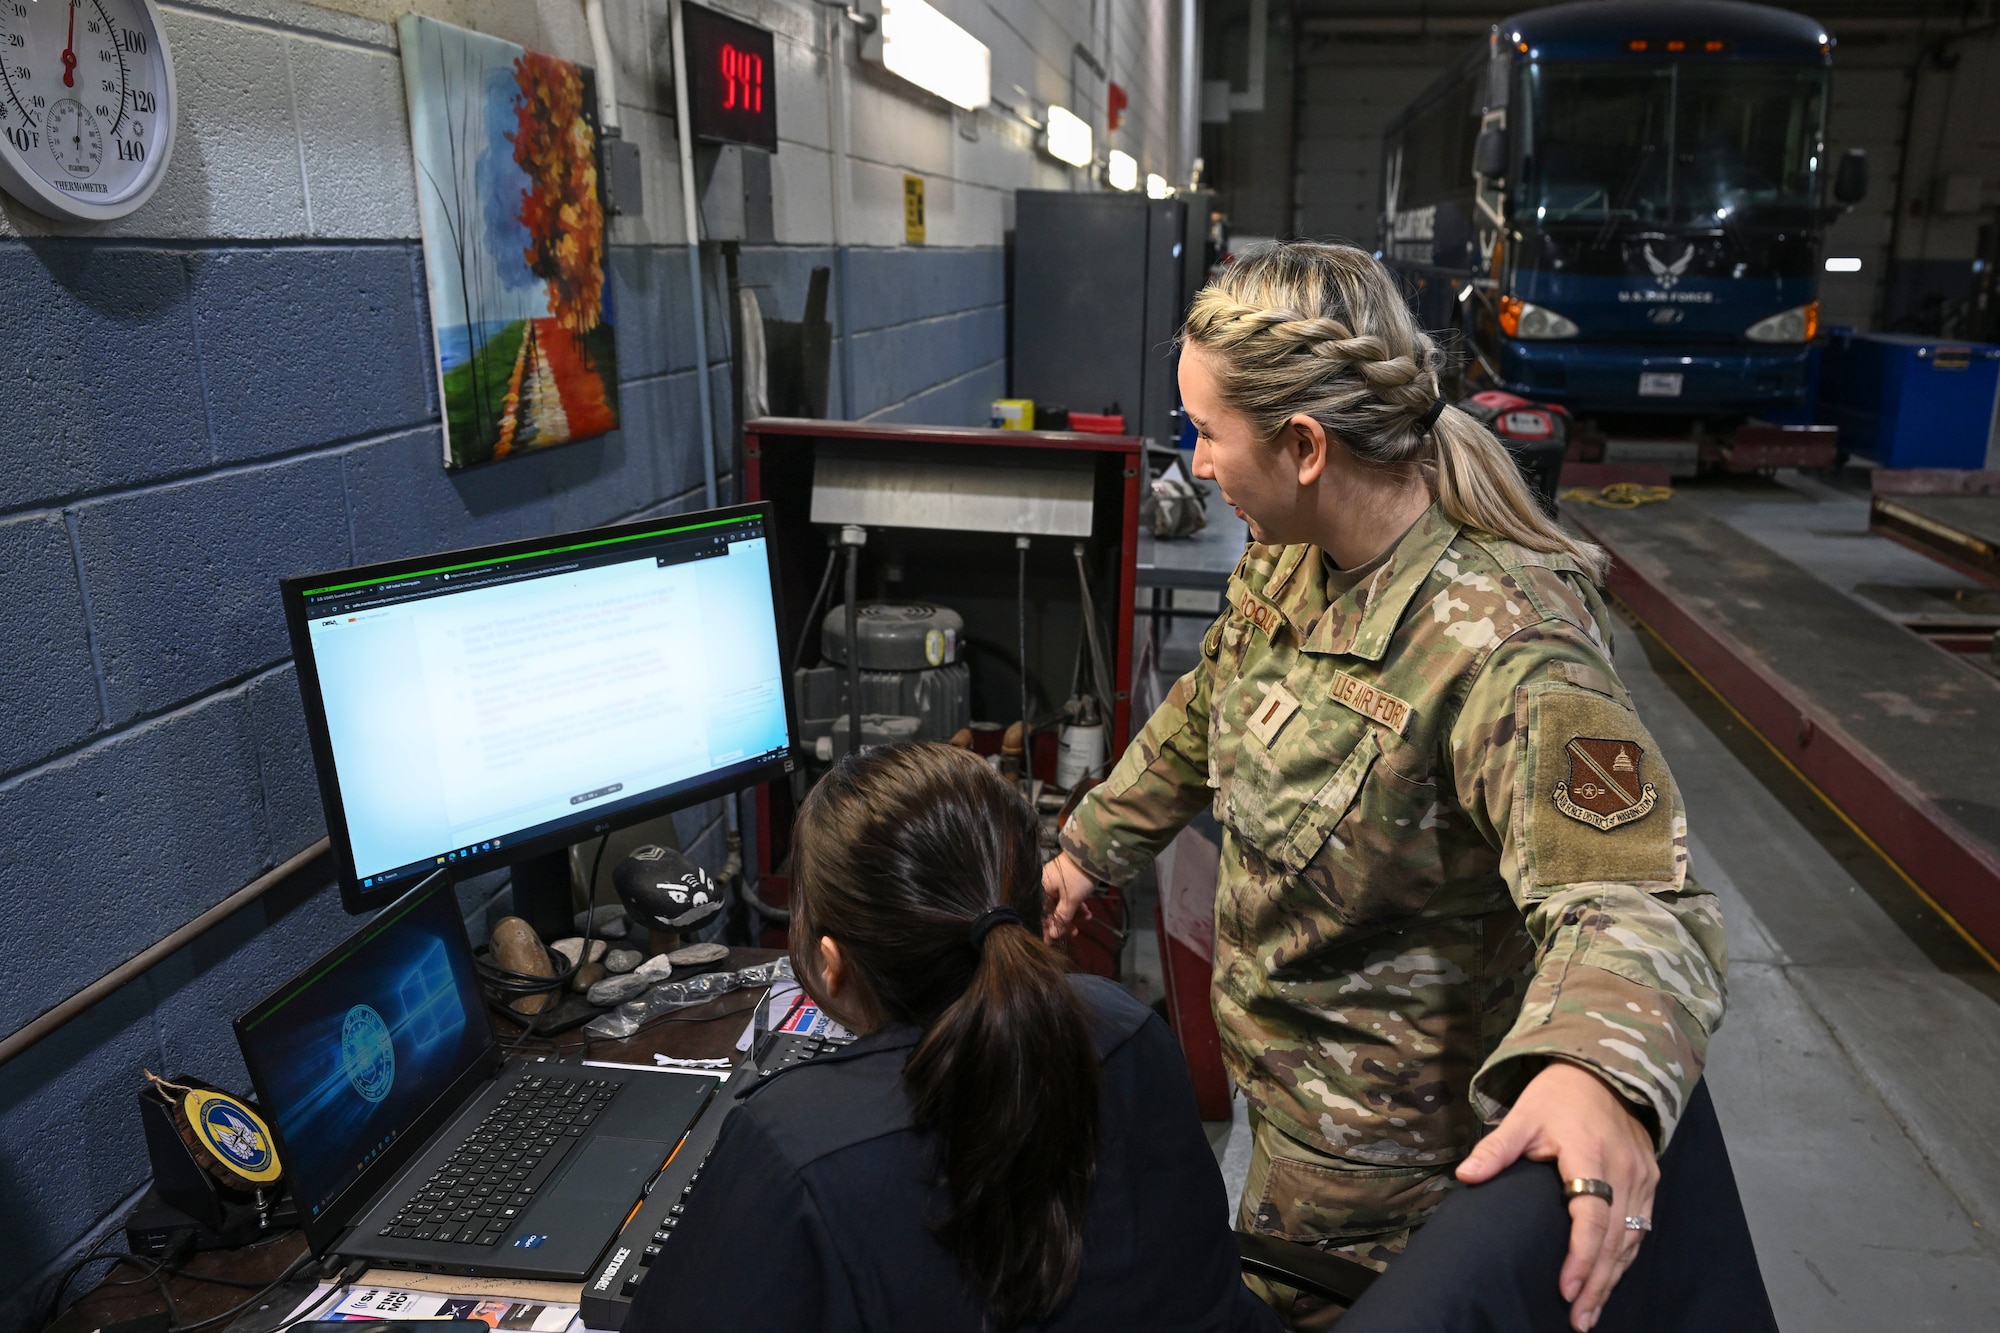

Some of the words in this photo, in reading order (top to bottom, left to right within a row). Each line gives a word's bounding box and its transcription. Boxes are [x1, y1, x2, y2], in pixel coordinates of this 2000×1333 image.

[88, 21, 100, 34] 30
[8, 34, 24, 48] -20
[121, 28, 147, 55] 100
[98, 50, 111, 62] 40
[102, 80, 115, 93] 50
[132, 89, 156, 114] 120
[96, 105, 109, 117] 60
[116, 139, 145, 162] 140
[54, 181, 108, 193] THERMOMETER
[1240, 593, 1277, 636] ROQUE
[1352, 685, 1374, 713] AIR
[1564, 803, 1582, 818] FORCE
[1582, 811, 1609, 829] DISTRICT
[1615, 798, 1653, 821] WASHINGTON
[629, 1274, 638, 1283] Esc
